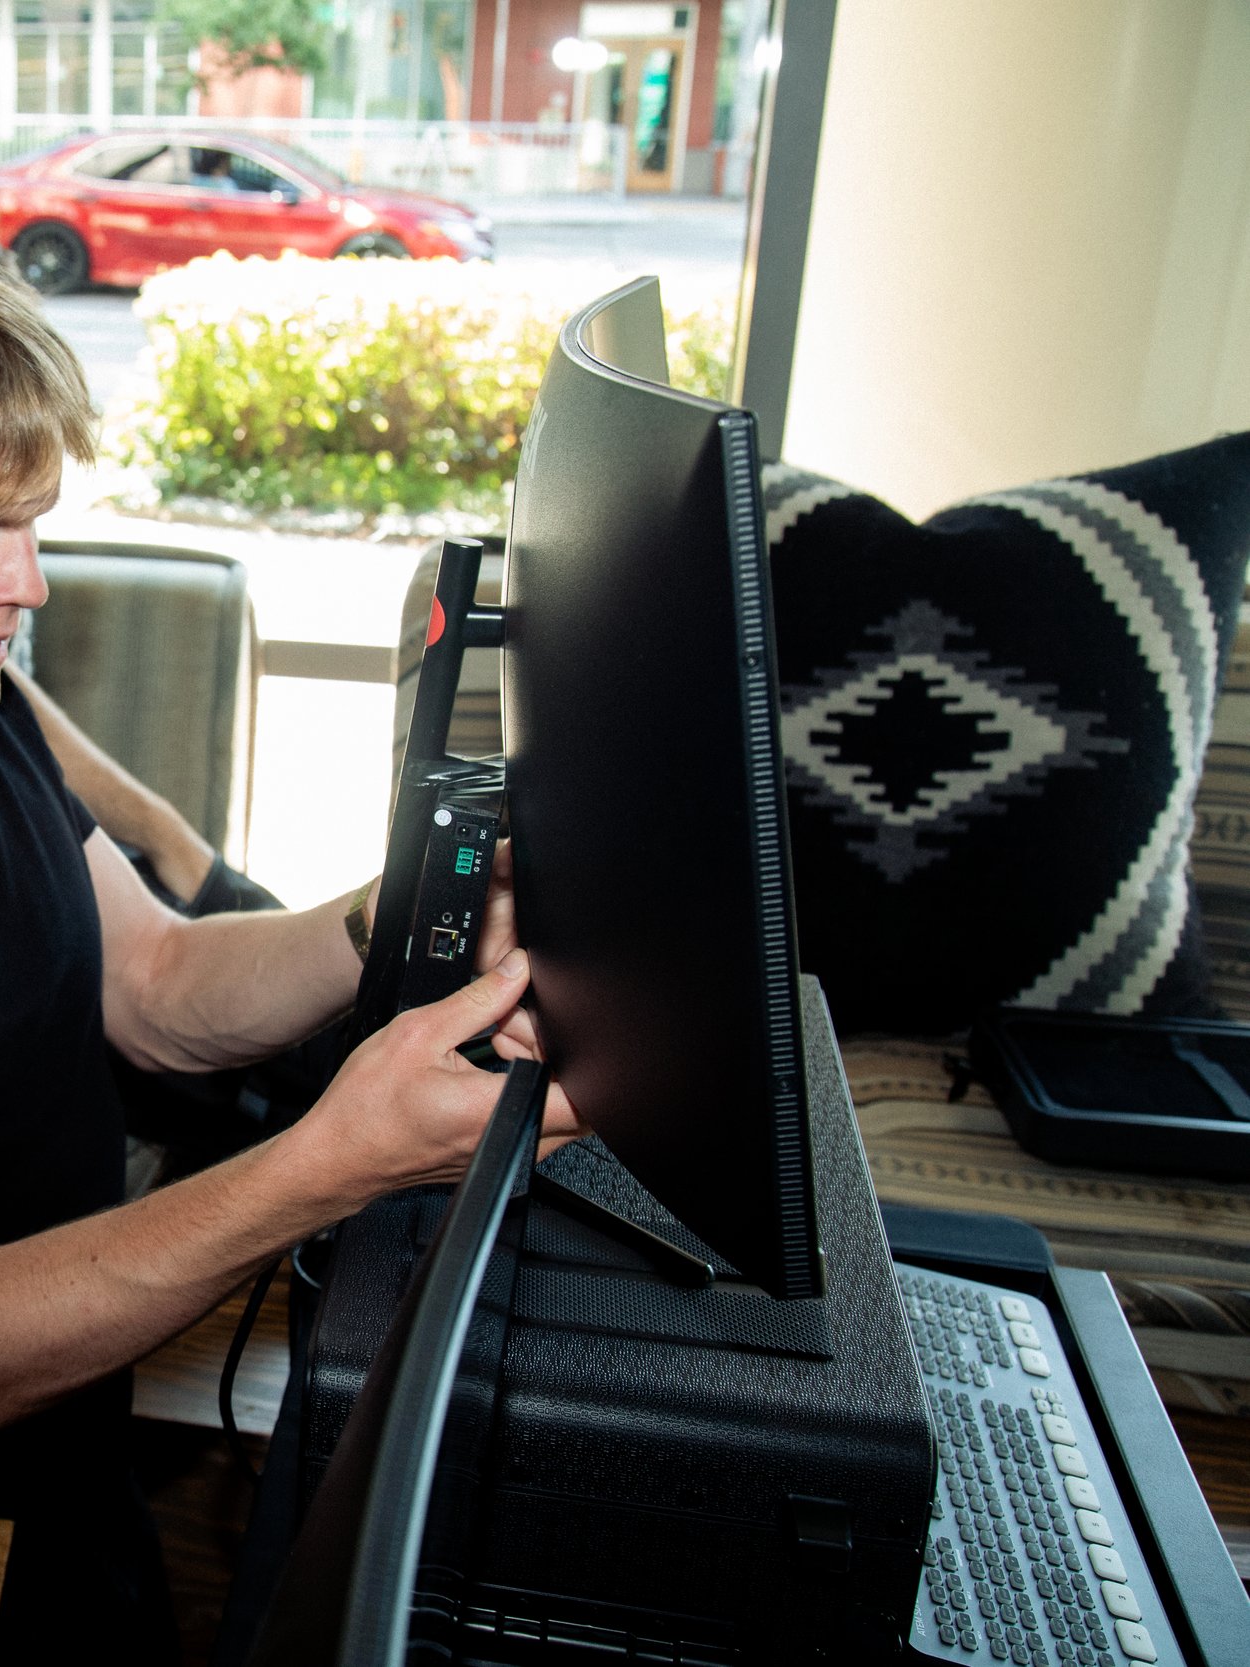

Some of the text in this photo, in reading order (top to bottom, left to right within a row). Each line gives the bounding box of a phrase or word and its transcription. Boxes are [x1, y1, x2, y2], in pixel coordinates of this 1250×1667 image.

[479, 829, 487, 840] DC
[463, 911, 472, 929] IR IN
[457, 937, 467, 954] RJ45
[914, 1616, 926, 1636] ATEM
